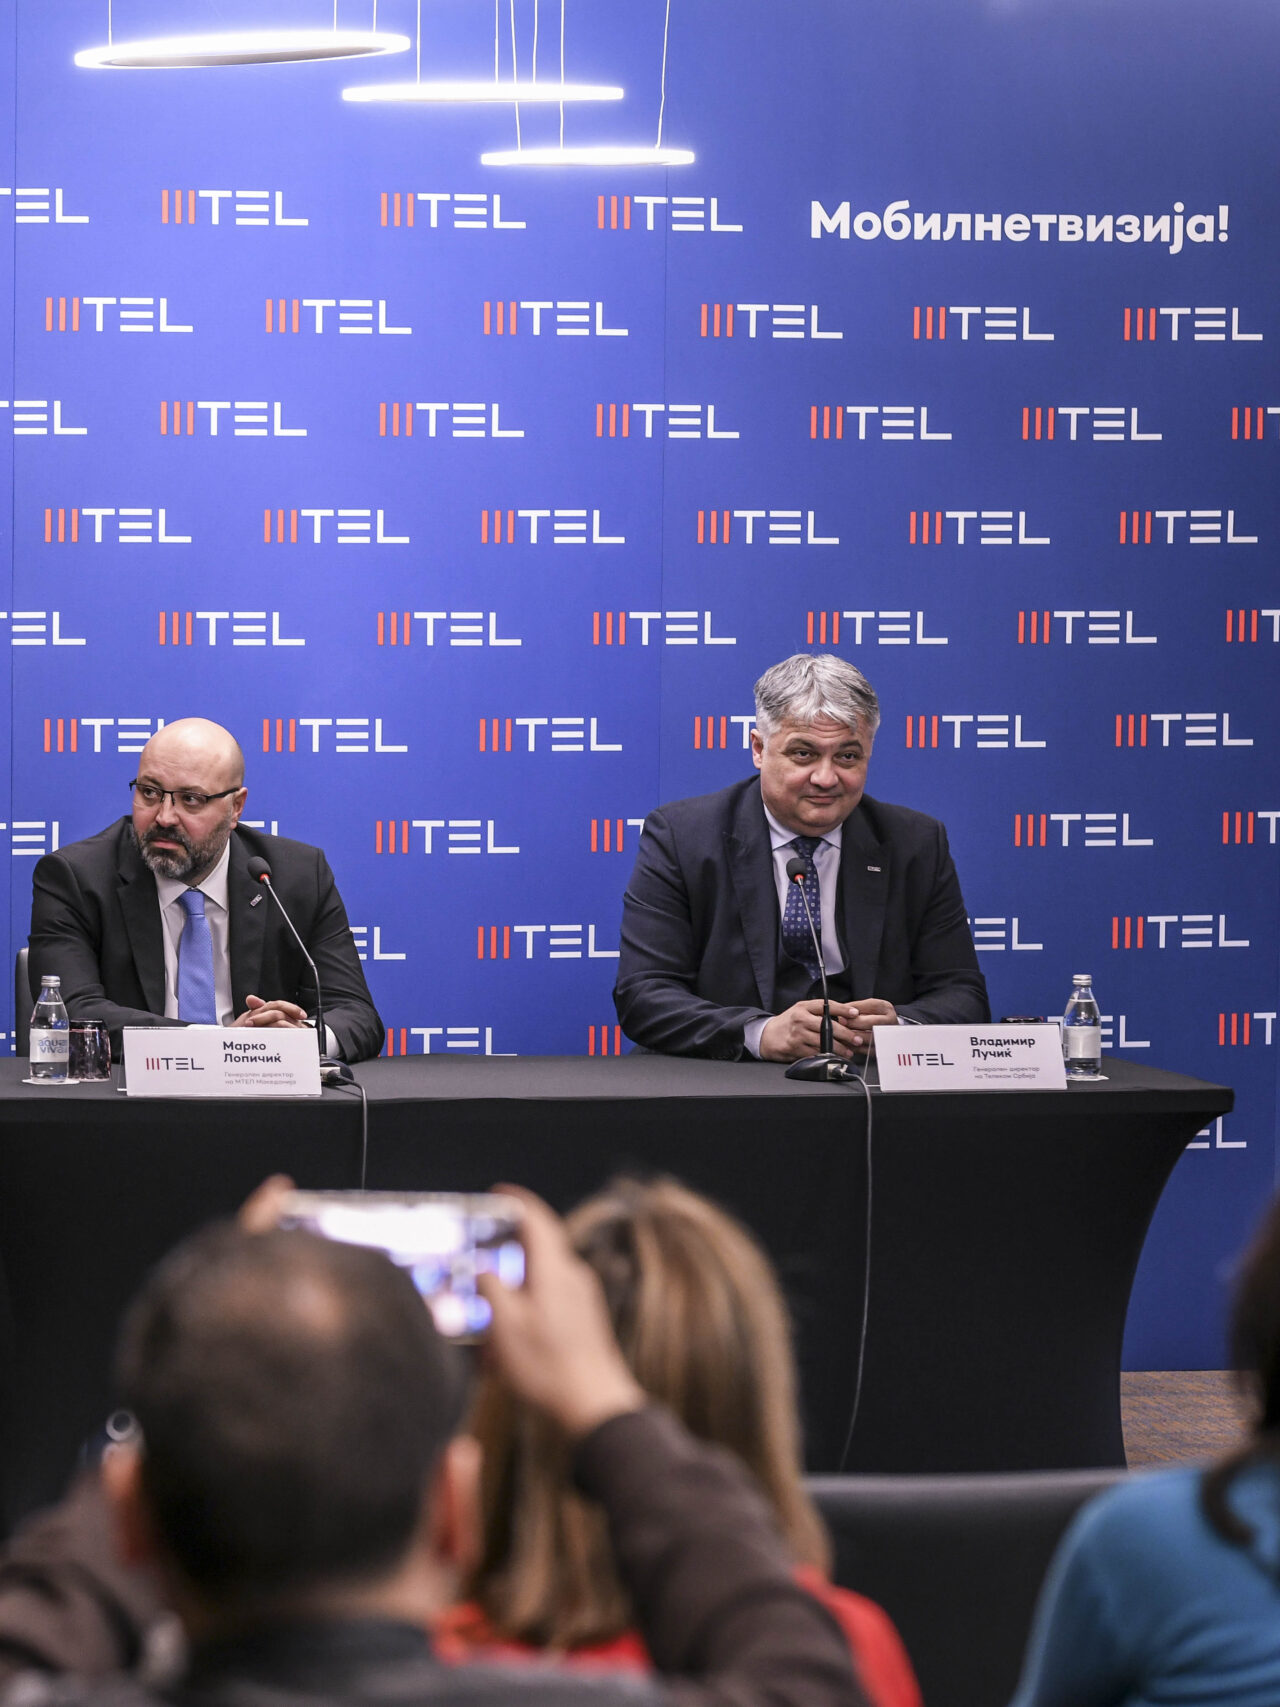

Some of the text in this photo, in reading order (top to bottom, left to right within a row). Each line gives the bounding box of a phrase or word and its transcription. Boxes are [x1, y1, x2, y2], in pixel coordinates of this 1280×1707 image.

[810, 200, 1229, 254] Мобилнетвизија!
[223, 1041, 267, 1053] Марко
[970, 1037, 1036, 1048] Владимир
